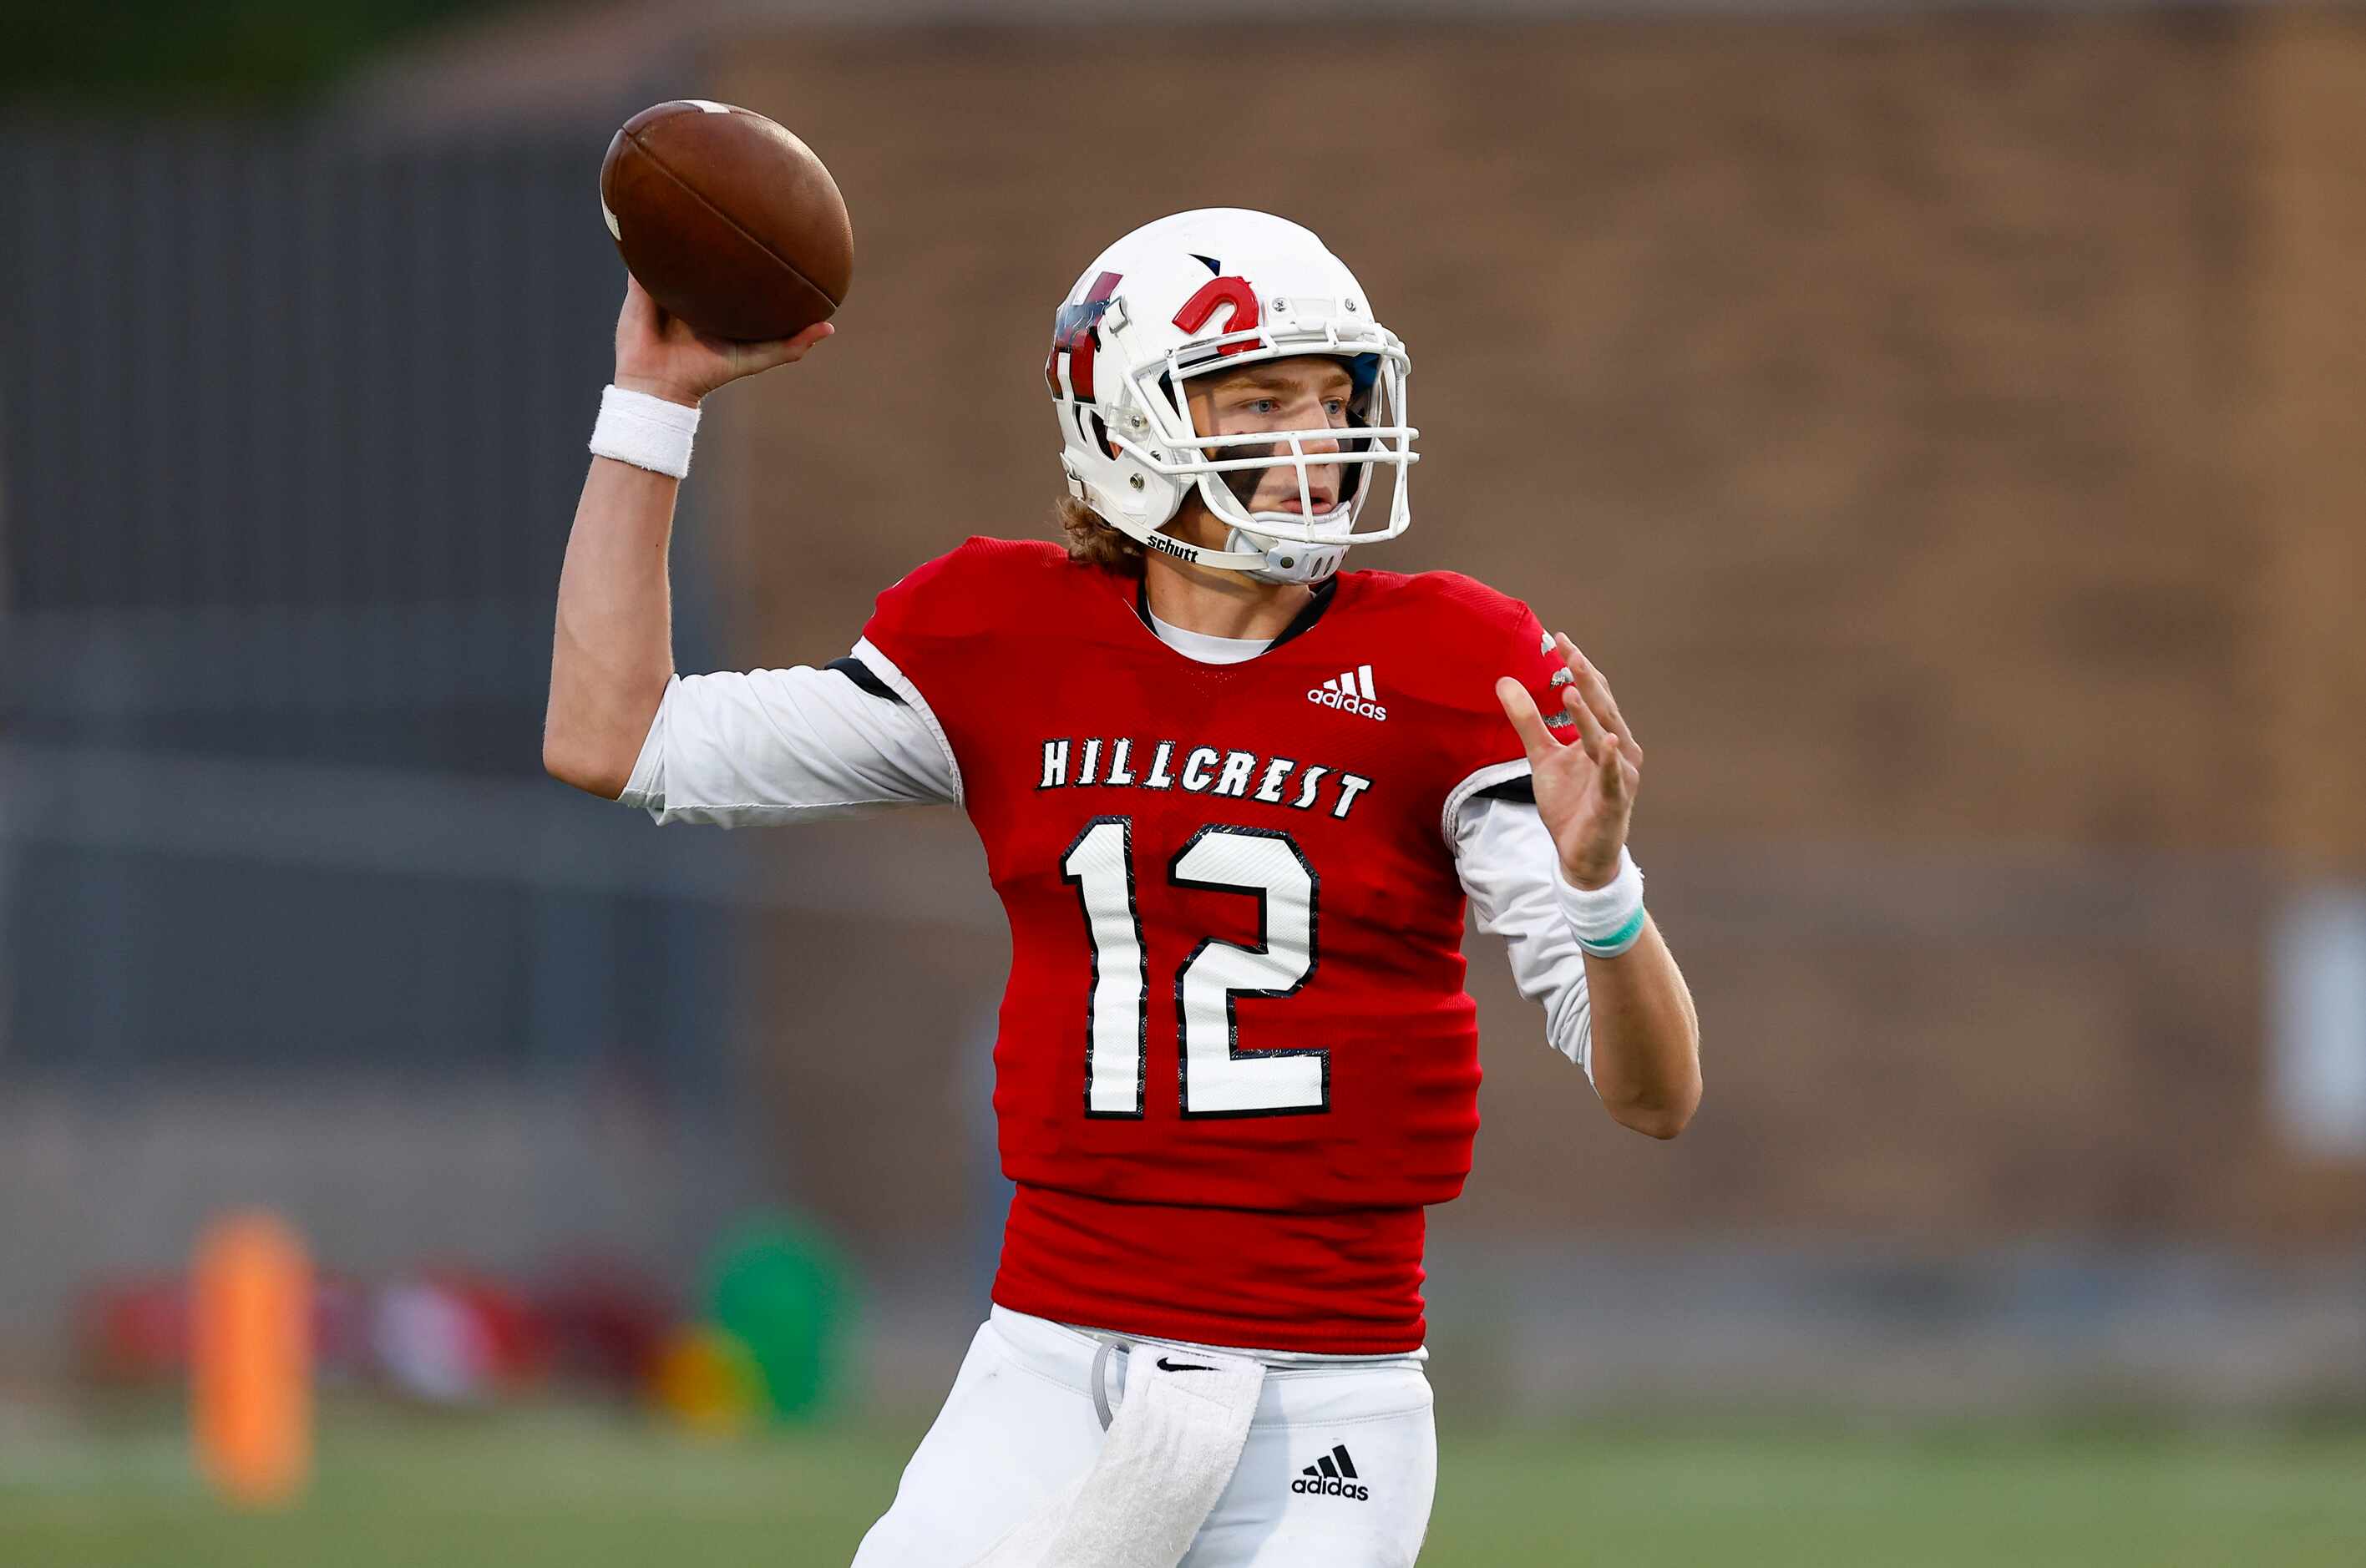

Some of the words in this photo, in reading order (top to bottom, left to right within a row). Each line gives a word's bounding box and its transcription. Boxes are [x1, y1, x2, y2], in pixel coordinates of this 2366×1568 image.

[1147, 534, 1198, 563] schutt
[1307, 689, 1386, 721] adidas
[1038, 738, 1372, 819] HILLCREST
[1060, 815, 1330, 1120] 12
[1291, 1476, 1369, 1501] adidas
